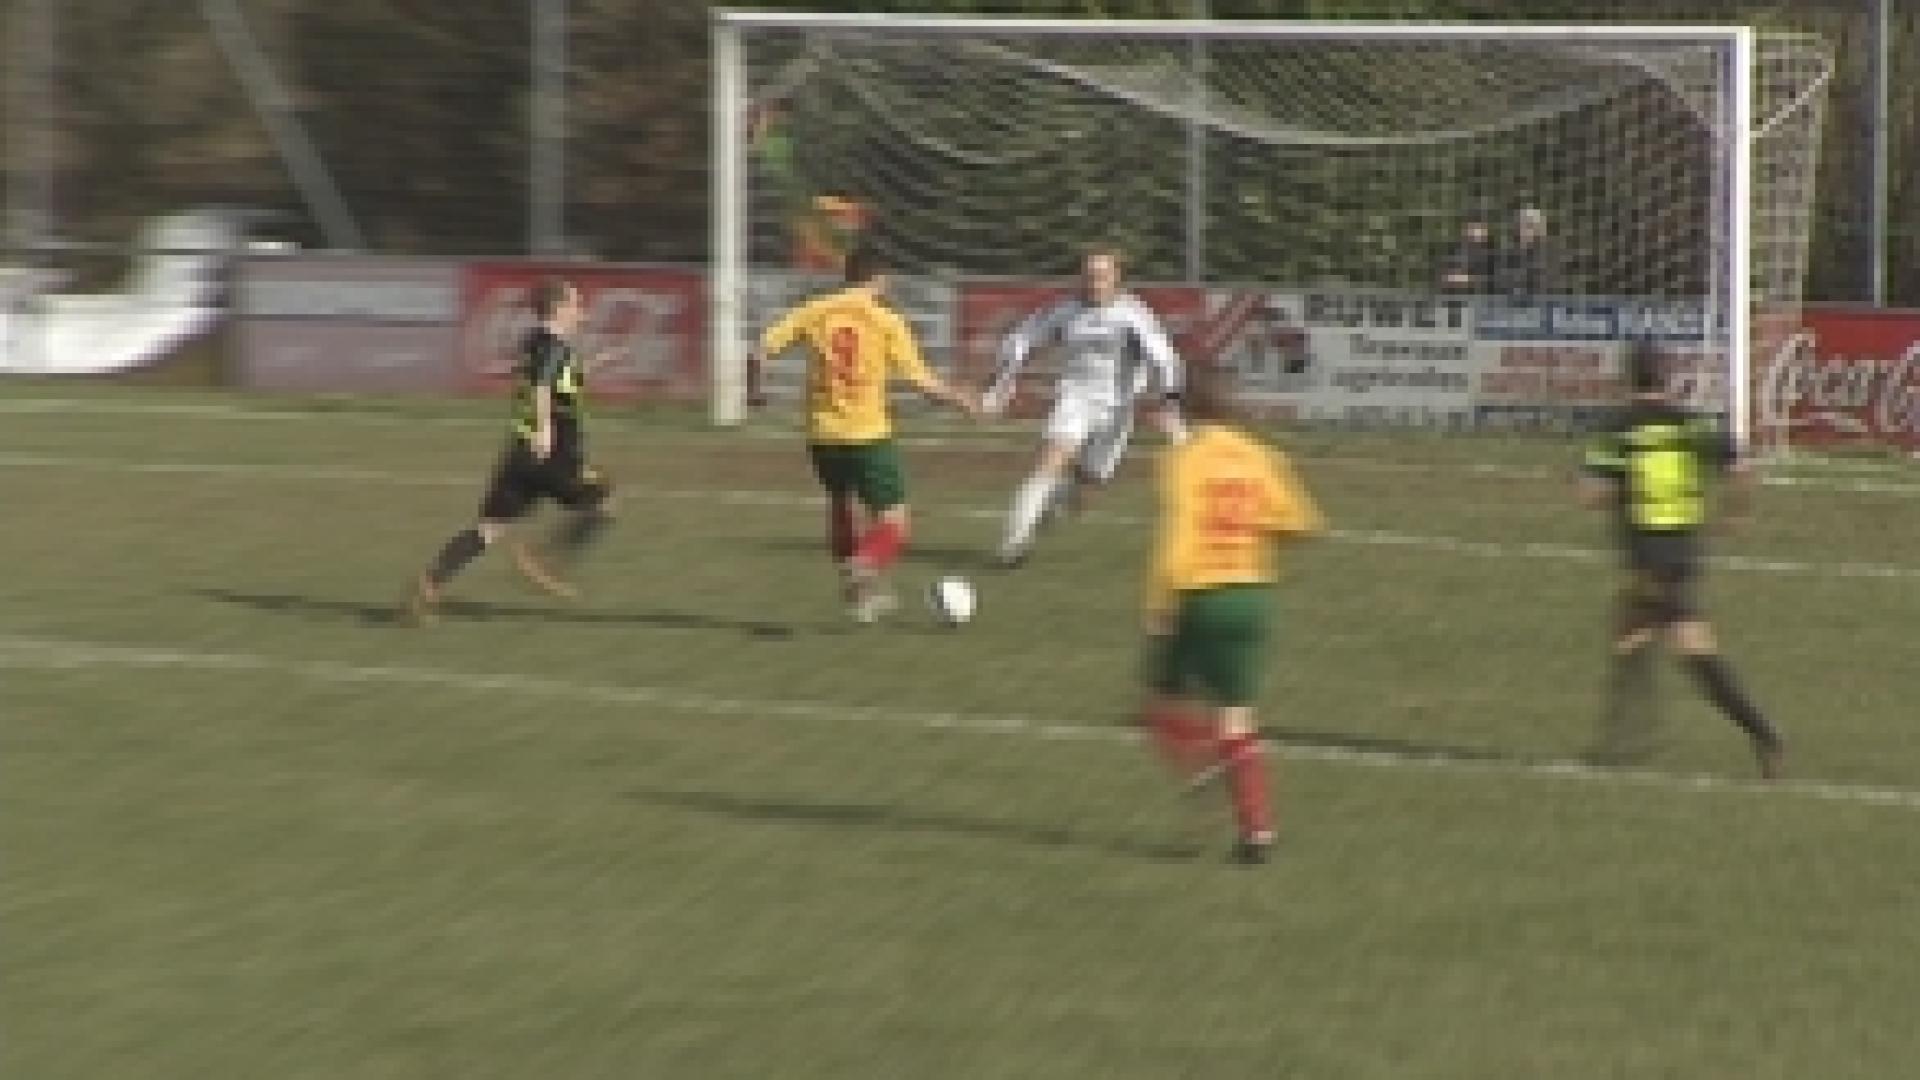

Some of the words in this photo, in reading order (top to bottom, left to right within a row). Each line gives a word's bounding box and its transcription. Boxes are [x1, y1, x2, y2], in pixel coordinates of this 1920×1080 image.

[1304, 294, 1468, 328] RUWET
[1349, 334, 1468, 359] Travaux
[1331, 366, 1468, 392] agricoles
